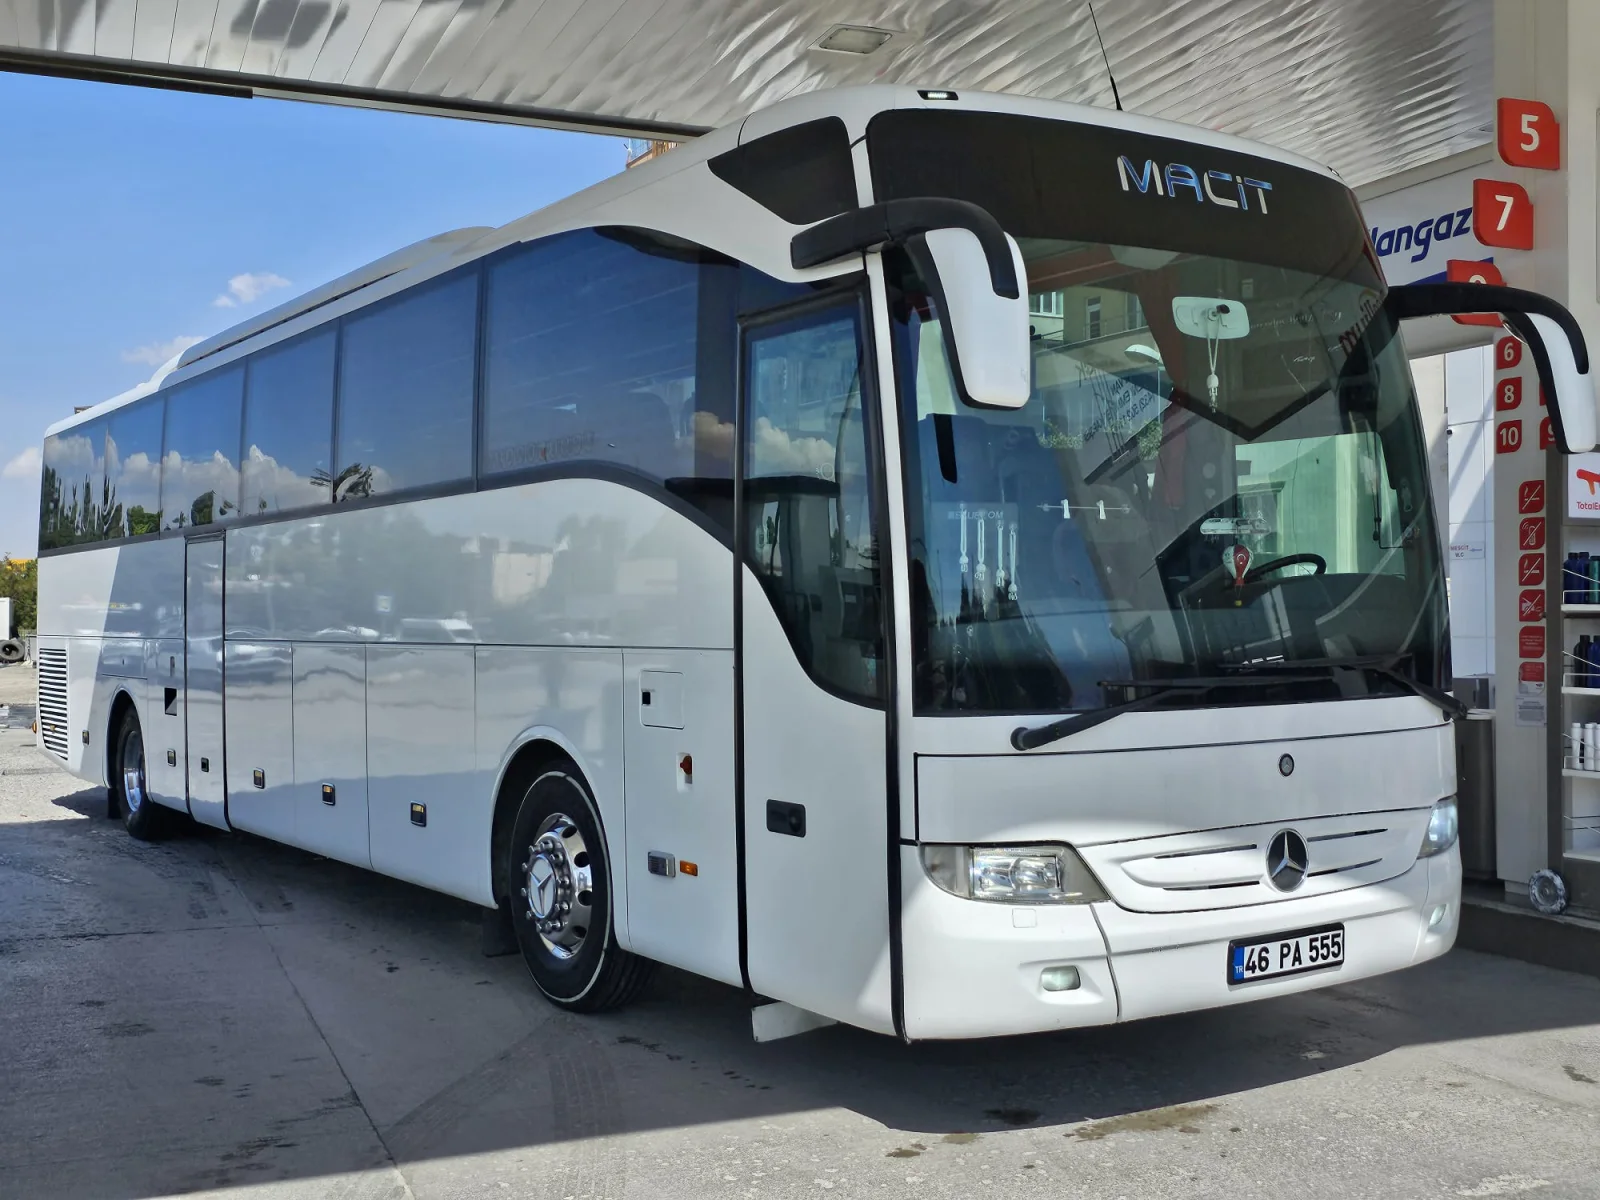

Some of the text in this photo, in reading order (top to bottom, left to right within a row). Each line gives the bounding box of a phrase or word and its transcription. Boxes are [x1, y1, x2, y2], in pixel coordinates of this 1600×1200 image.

[1520, 113, 1540, 152] 5
[1494, 194, 1514, 231] 7
[1370, 206, 1473, 263] langaz
[1503, 342, 1514, 361] 6
[1504, 384, 1515, 404] 8
[1499, 426, 1519, 446] 10
[1235, 932, 1342, 974] TR 46 PA 555
